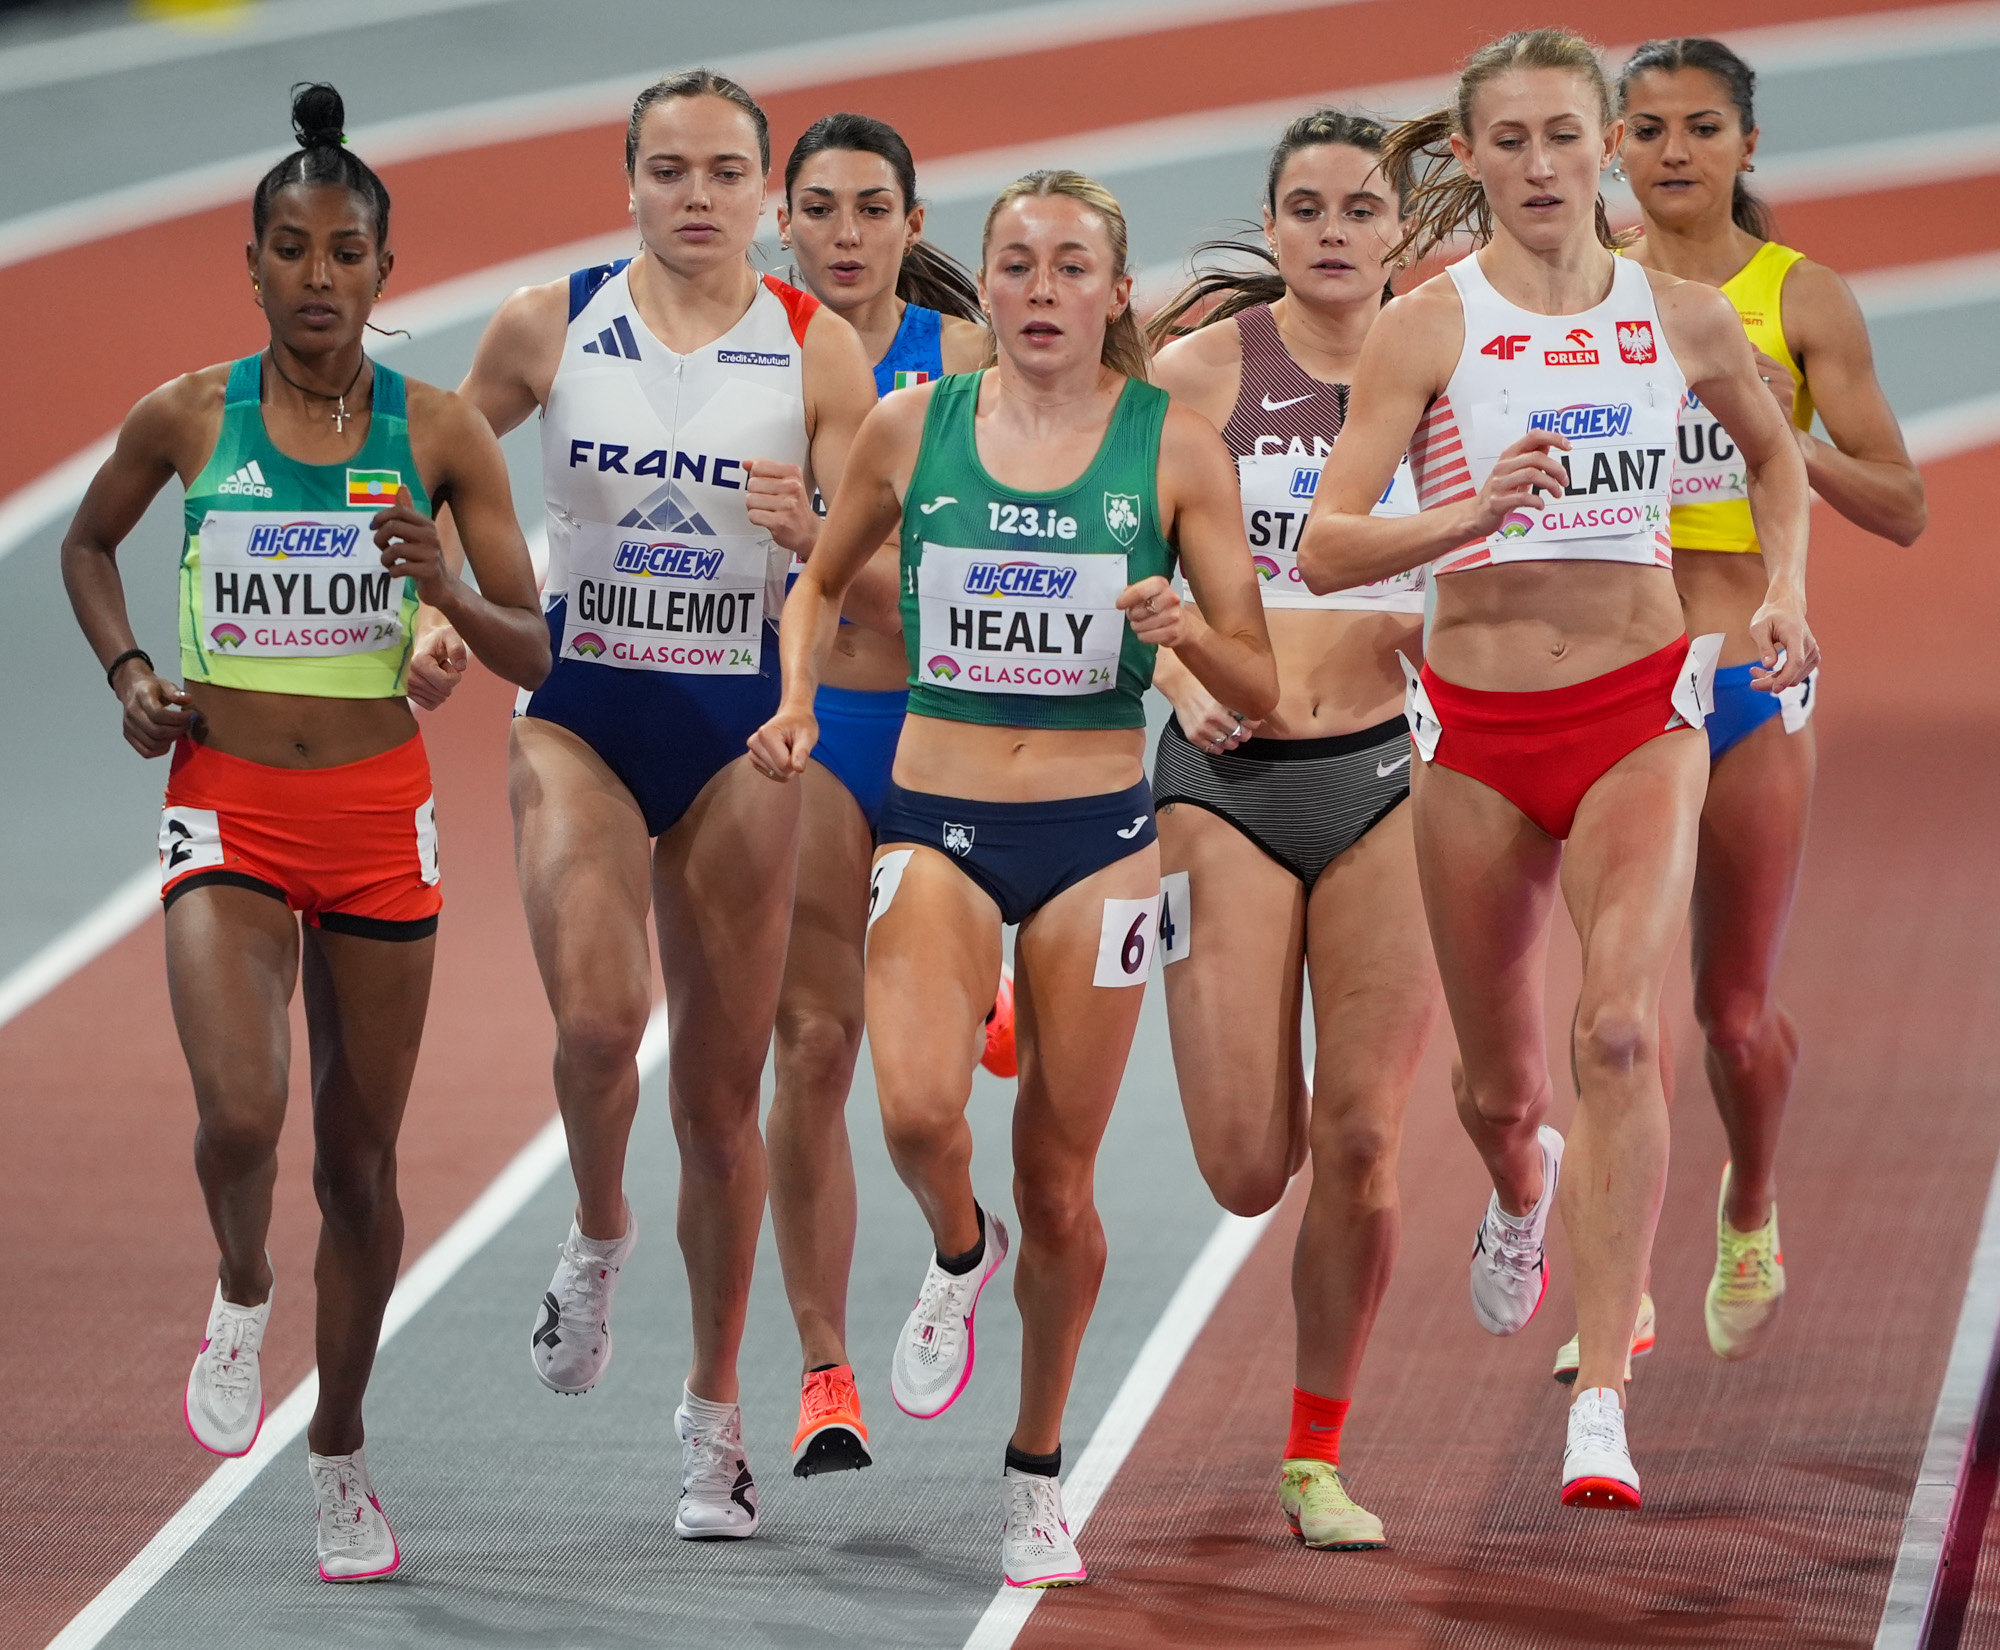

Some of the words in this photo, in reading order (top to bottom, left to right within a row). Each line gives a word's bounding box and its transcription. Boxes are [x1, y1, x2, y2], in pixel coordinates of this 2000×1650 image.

[719, 352, 749, 364] Crédit
[758, 354, 790, 366] Mutuel
[1480, 335, 1531, 360] 4F
[1547, 351, 1597, 365] ORLEN
[570, 439, 751, 491] FRANC
[1532, 449, 1666, 497] LANT
[218, 482, 273, 499] adidas
[988, 502, 1078, 540] 123.ie
[1646, 505, 1660, 522] 24
[247, 524, 360, 558] HI-CHEW
[613, 541, 725, 581] HI-CHEW
[215, 572, 392, 615] HAYLOM
[963, 561, 1077, 599] HI-CHEW
[578, 579, 755, 634] GUILLEMOT
[254, 626, 370, 646] GLASGOW
[373, 623, 394, 641] 24
[949, 606, 1094, 655] HEALY
[613, 642, 725, 666] GLASGOW
[729, 648, 753, 667] 24
[967, 664, 1084, 686] GLASGOW
[1088, 667, 1110, 685] 24
[1121, 912, 1148, 975] 6
